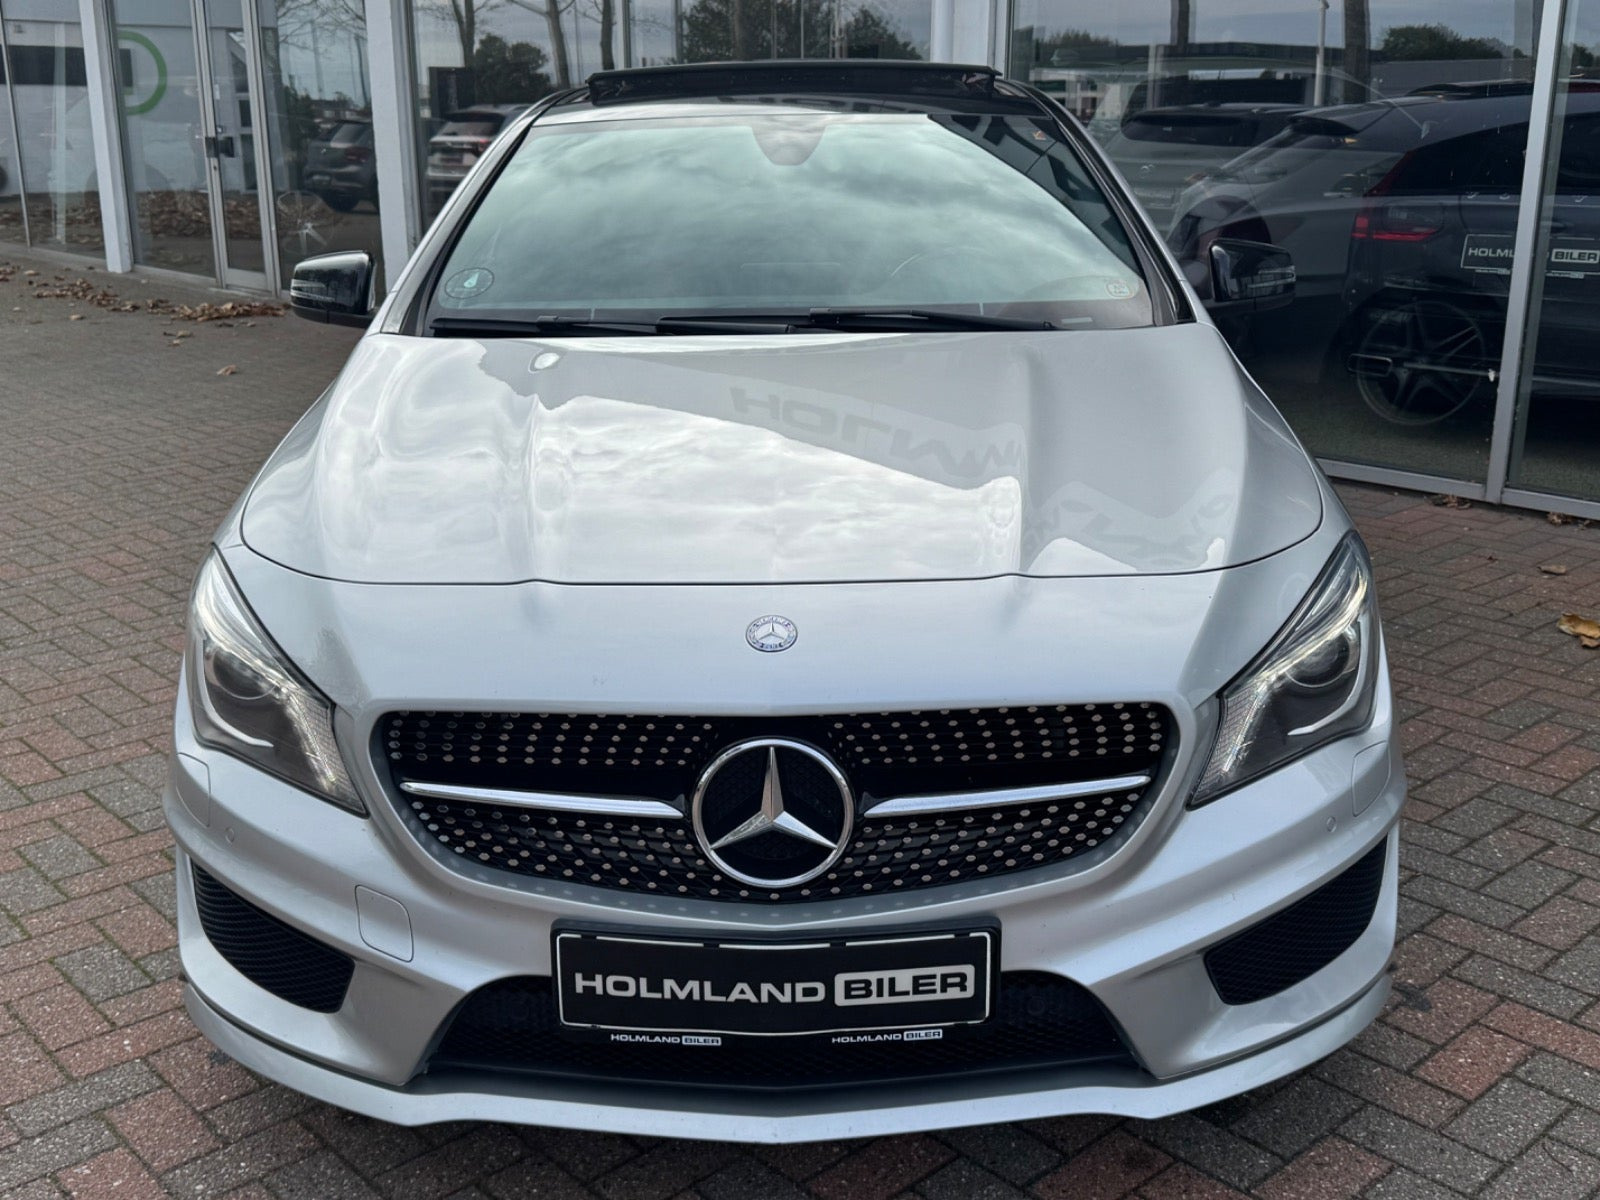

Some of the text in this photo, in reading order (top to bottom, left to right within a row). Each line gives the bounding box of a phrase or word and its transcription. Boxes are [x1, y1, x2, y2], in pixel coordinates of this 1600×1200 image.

[1554, 250, 1599, 262] BILER
[575, 971, 968, 1003] HOLMLAND BILER
[610, 1033, 721, 1045] HOLMLAND BILER
[832, 1030, 942, 1043] HOLMLAND BILER
